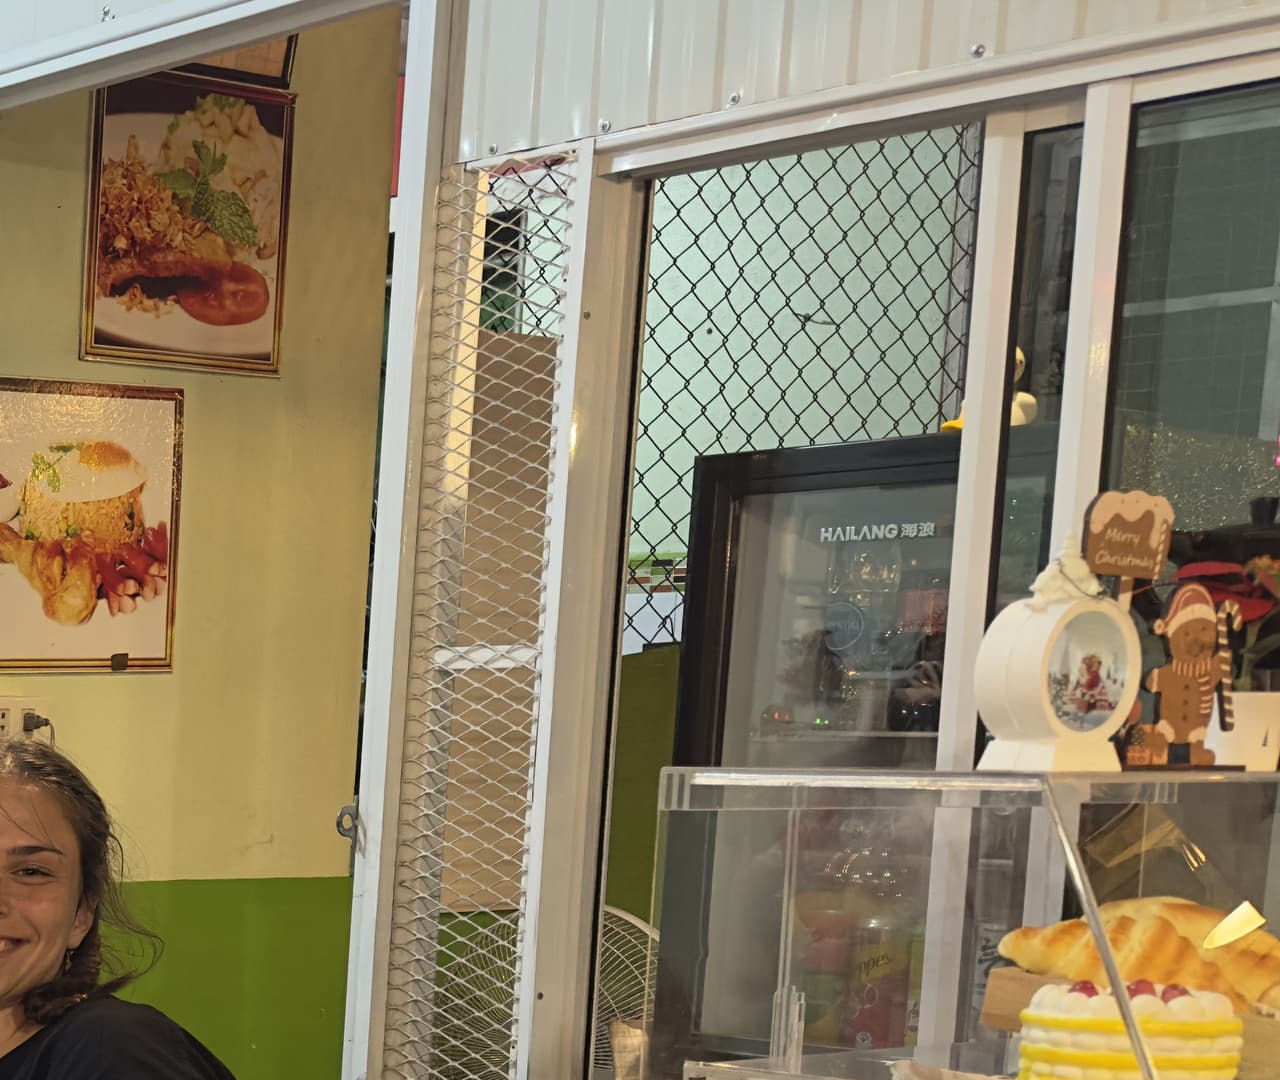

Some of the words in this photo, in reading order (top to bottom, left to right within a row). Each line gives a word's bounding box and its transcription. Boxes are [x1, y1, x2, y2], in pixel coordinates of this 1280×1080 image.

[820, 524, 898, 542] HAILANG
[900, 522, 936, 538] 海浪
[1105, 527, 1141, 547] Merry
